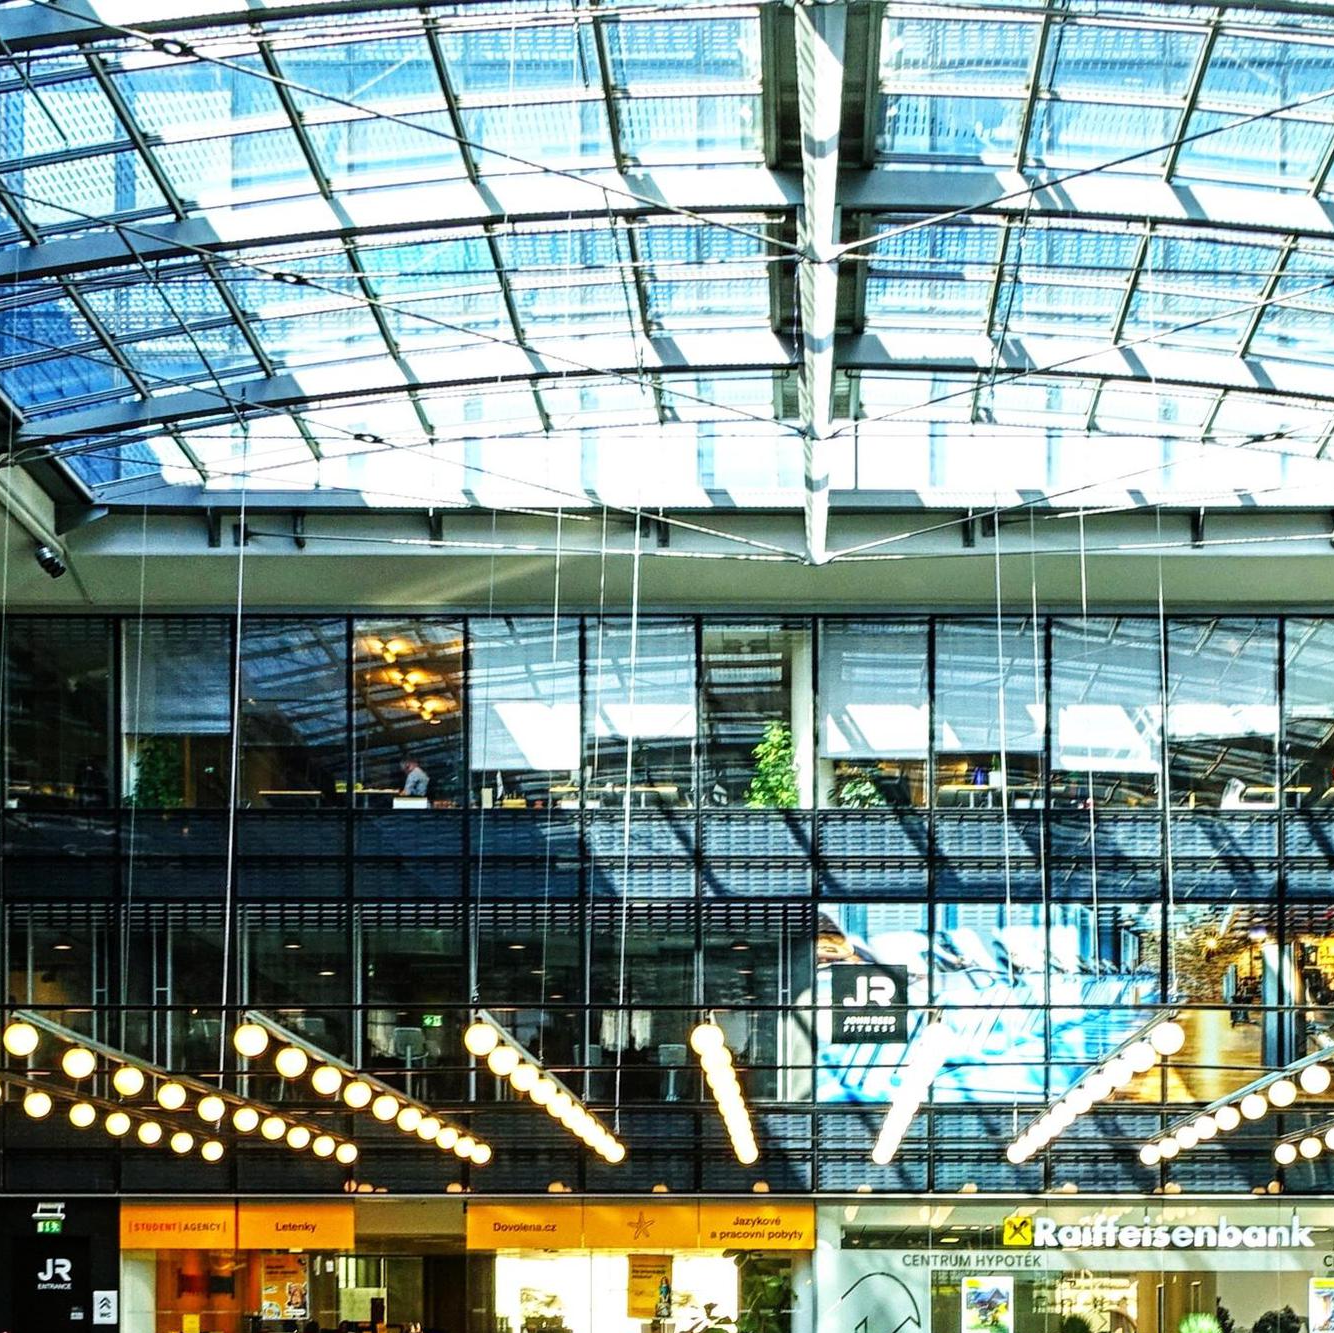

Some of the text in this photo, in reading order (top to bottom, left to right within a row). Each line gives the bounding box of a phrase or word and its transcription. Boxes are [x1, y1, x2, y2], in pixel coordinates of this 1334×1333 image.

[842, 976, 896, 1008] JR
[183, 1222, 221, 1232] AGENCY
[275, 1221, 317, 1233] Letenky
[492, 1221, 557, 1233] Dovolena.cz
[732, 1215, 781, 1228] Jazykové
[710, 1229, 804, 1243] a pracovní pobyty
[1033, 1215, 1316, 1248] Raiffeisenbank
[902, 1251, 1042, 1268] CENTRUM HYPOTÉK
[37, 1258, 72, 1282] JR
